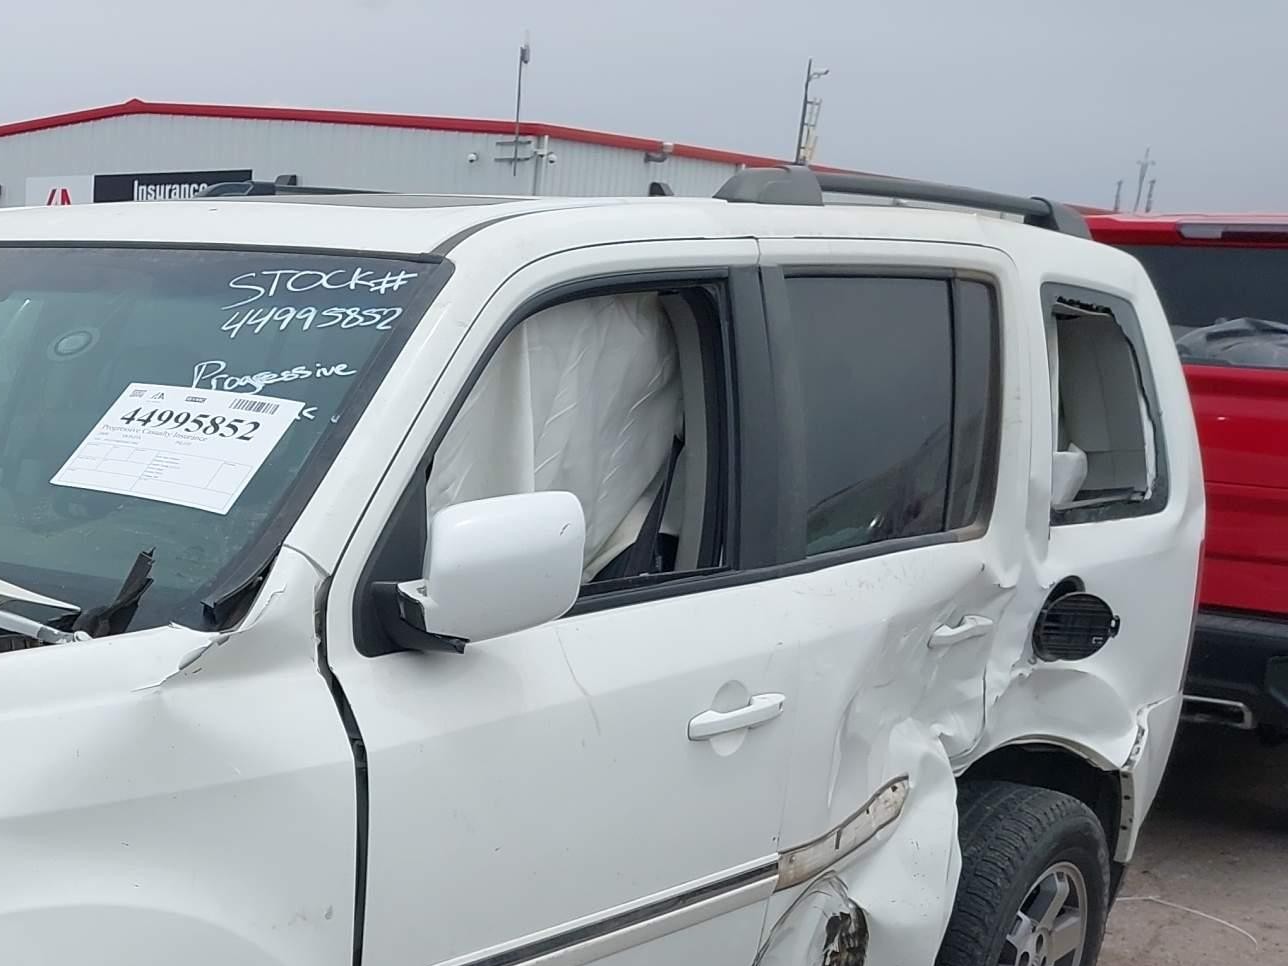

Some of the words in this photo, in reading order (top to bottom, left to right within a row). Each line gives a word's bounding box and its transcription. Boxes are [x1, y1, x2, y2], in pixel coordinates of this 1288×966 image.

[222, 267, 418, 310] STOCK#
[221, 306, 402, 339] 44995852
[120, 407, 261, 442] 44995852
[172, 431, 209, 441] Insurance
